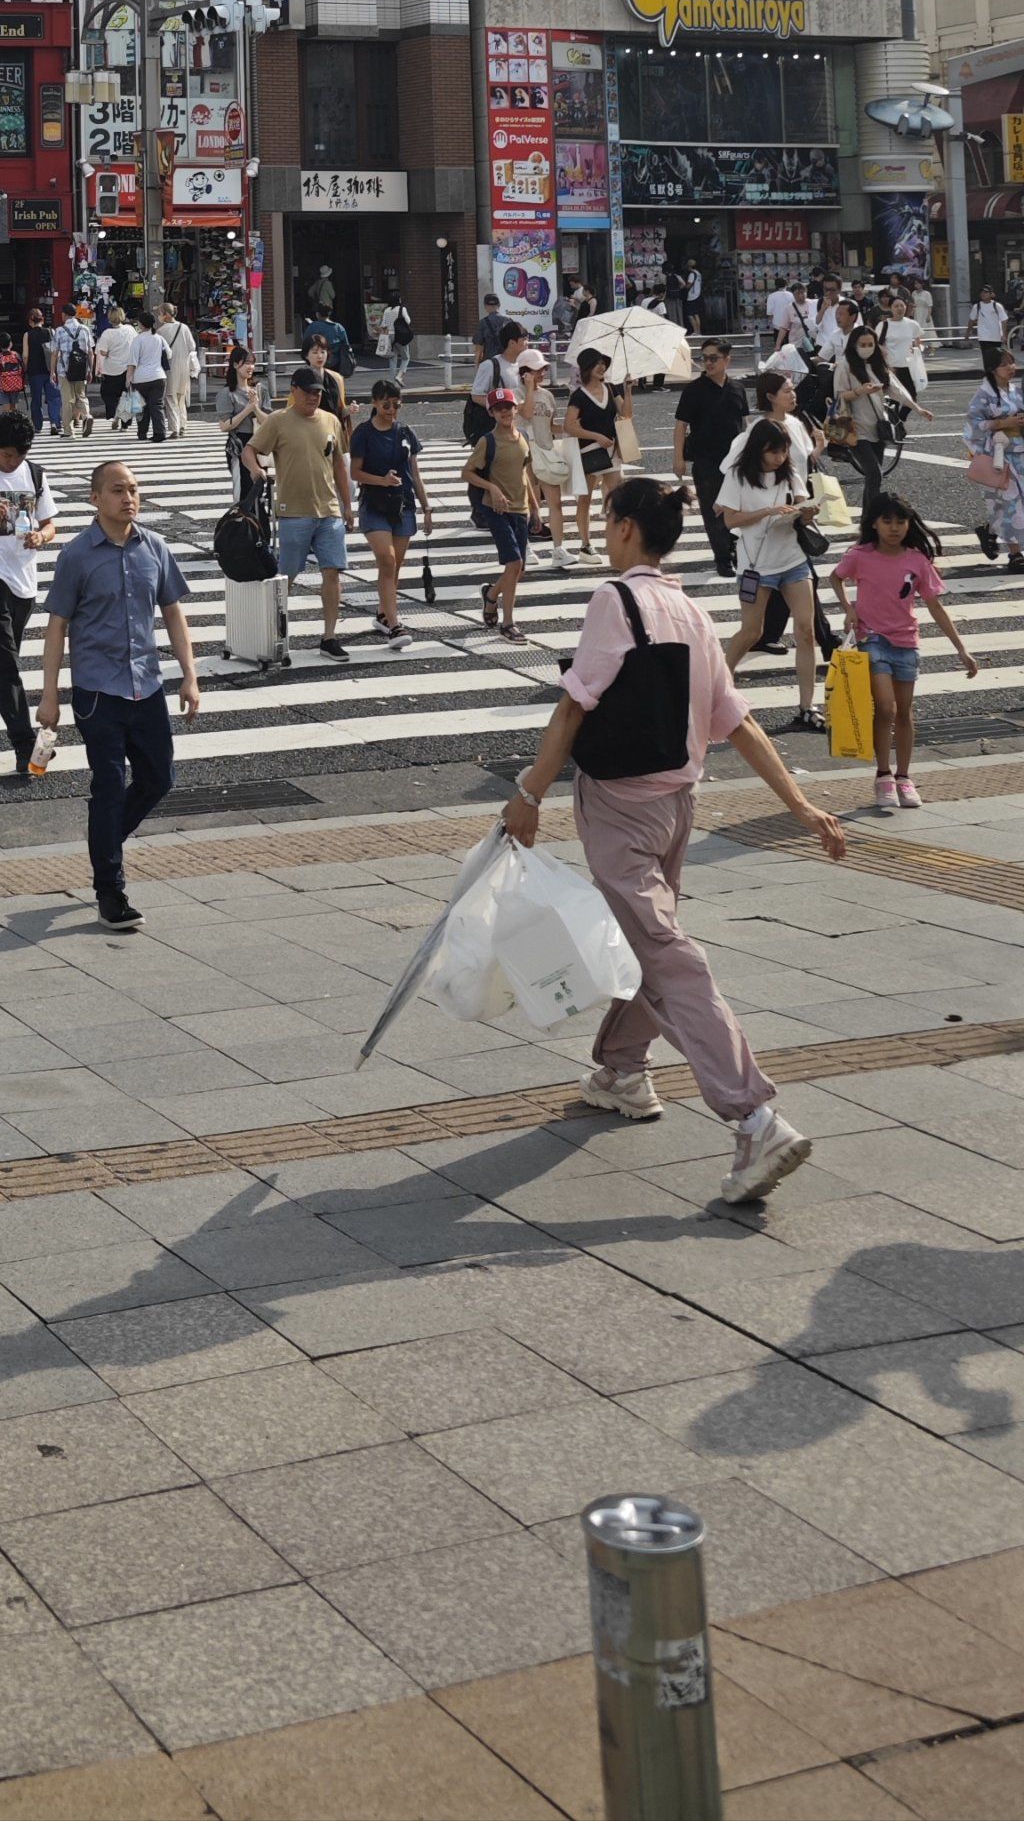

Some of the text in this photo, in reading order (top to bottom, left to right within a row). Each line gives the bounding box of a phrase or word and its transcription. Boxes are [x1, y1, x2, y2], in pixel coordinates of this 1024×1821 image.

[0, 24, 25, 37] End
[89, 99, 134, 125] 3階
[89, 128, 134, 156] 2階
[198, 135, 225, 148] LONDO
[509, 134, 549, 145] PalVerse
[649, 182, 683, 197] 怪獣8号
[14, 200, 26, 208] 2F
[14, 211, 58, 220] Irish Pub
